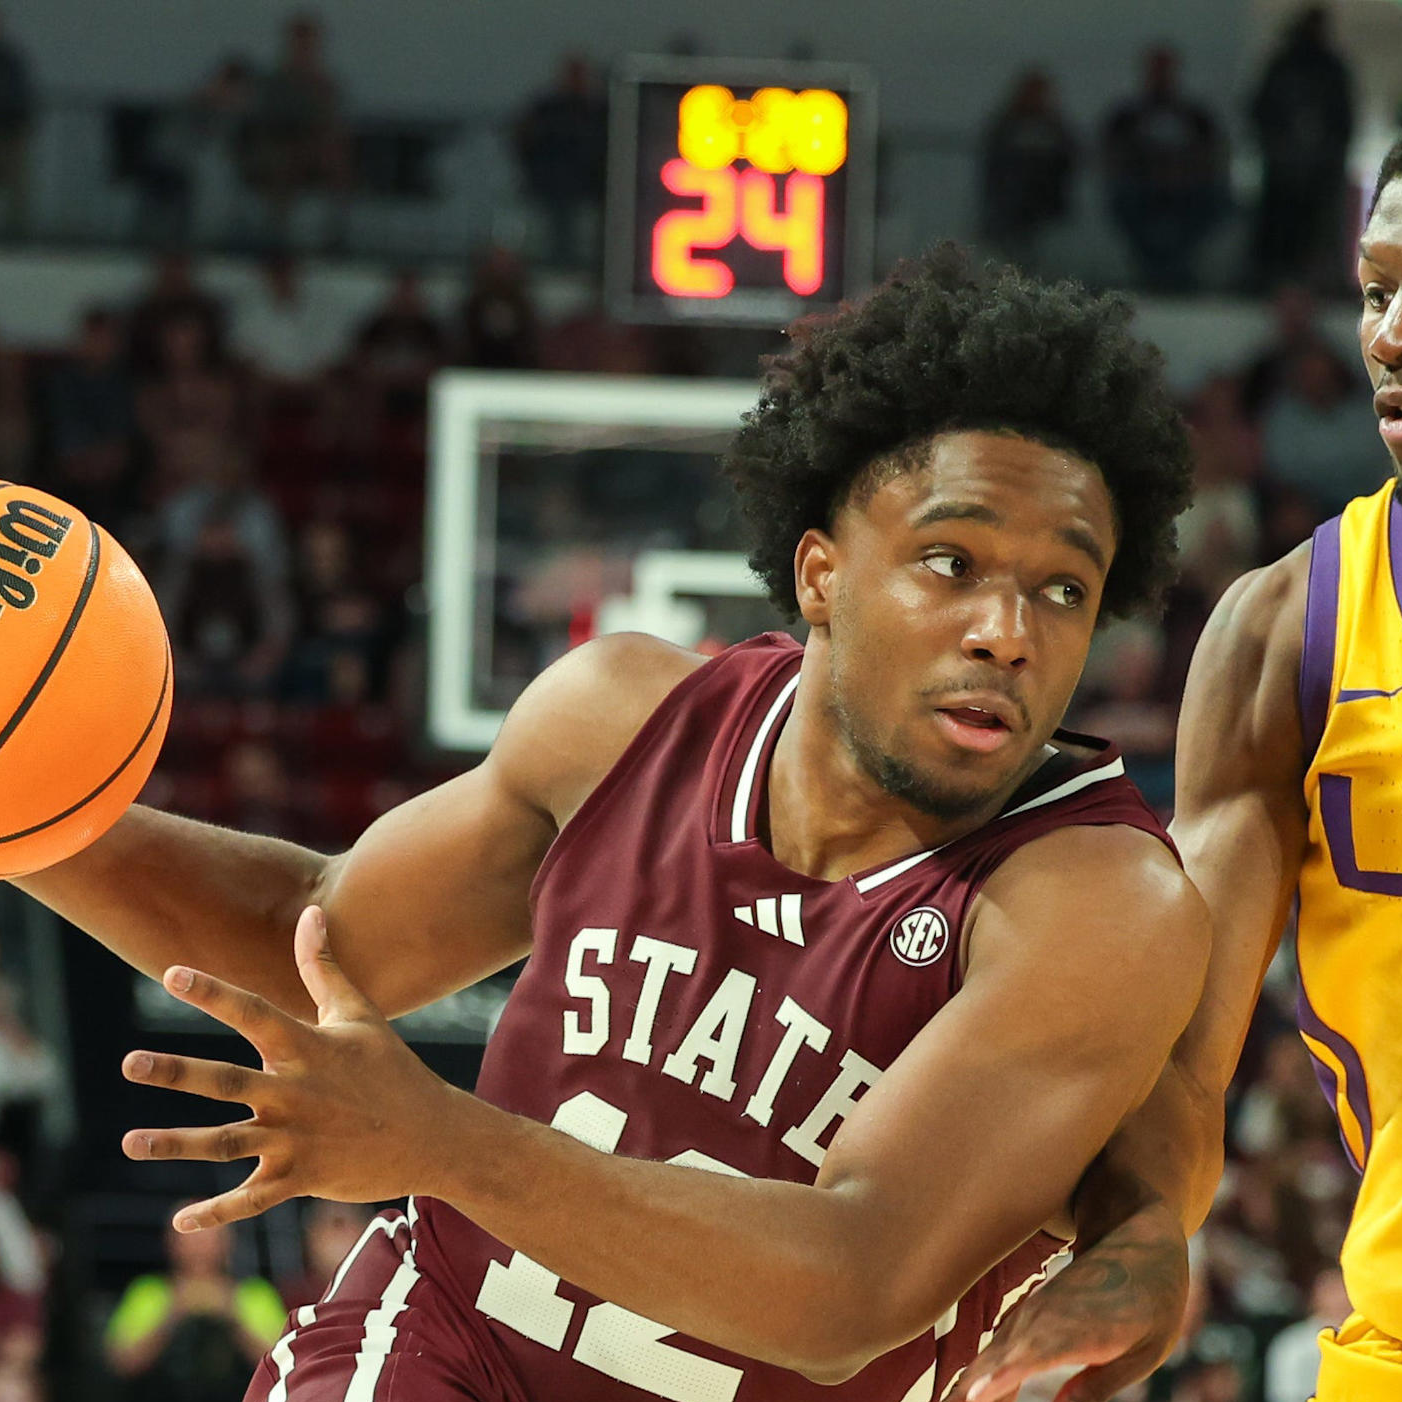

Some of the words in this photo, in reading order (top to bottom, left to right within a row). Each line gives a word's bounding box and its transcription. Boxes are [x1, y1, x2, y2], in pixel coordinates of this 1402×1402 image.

[652, 158, 825, 299] 24
[896, 912, 943, 961] SEC
[562, 927, 885, 1169] STATE
